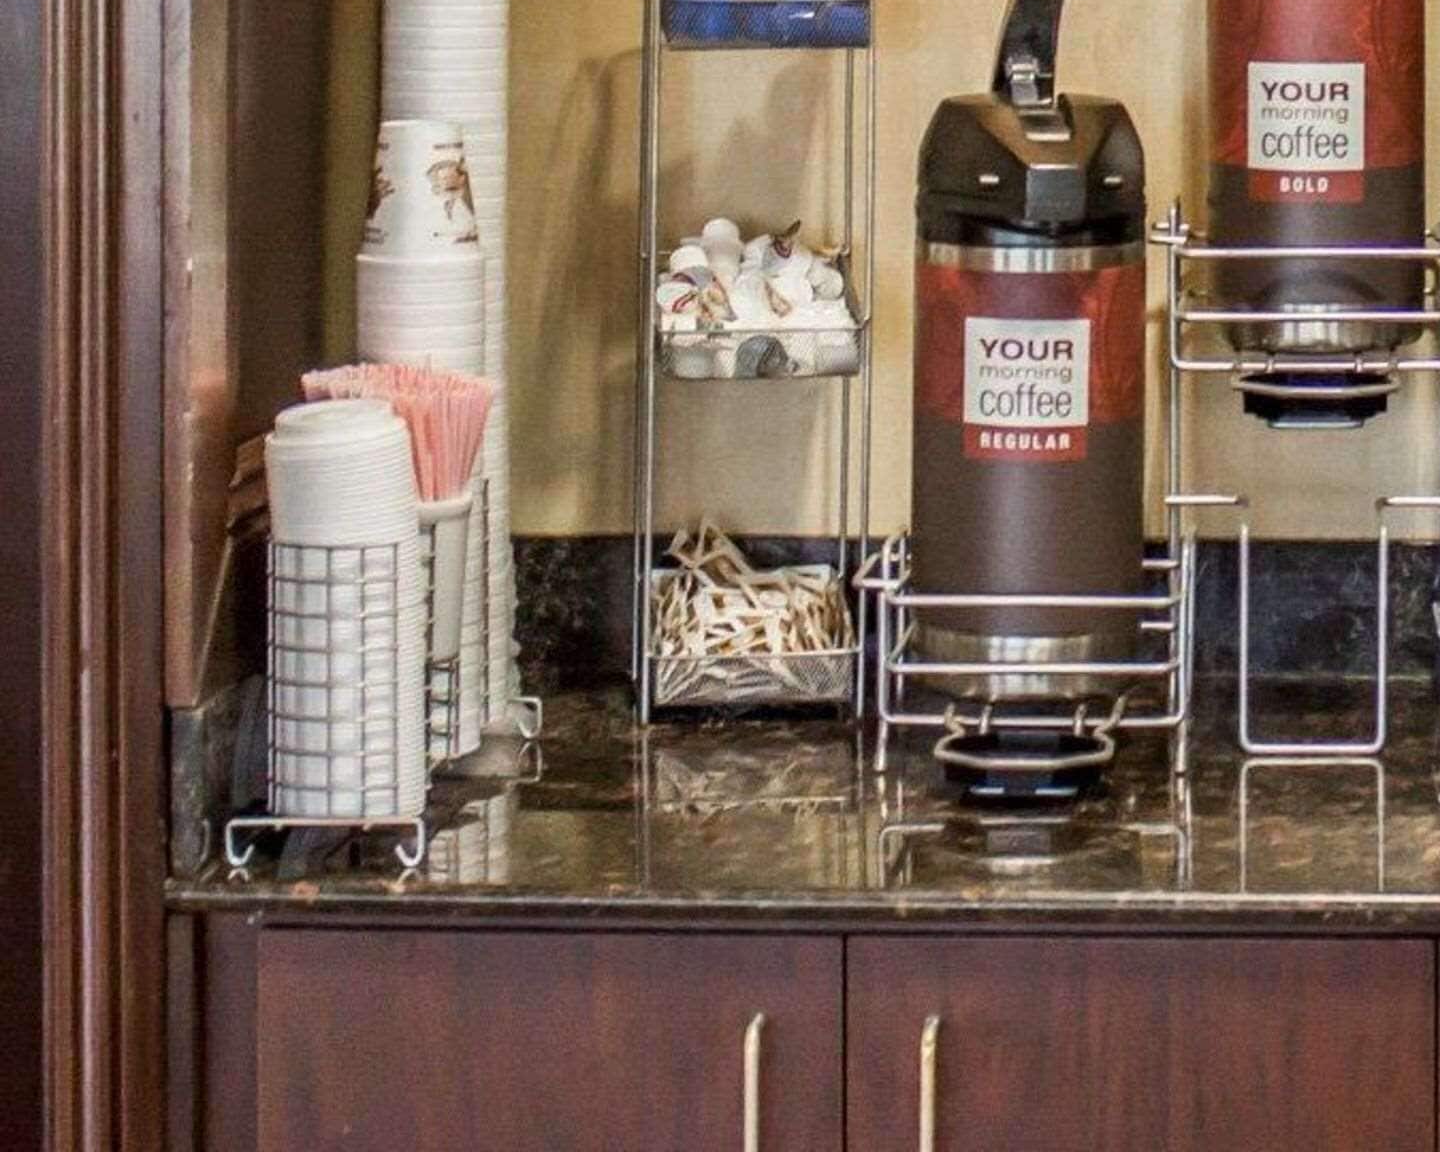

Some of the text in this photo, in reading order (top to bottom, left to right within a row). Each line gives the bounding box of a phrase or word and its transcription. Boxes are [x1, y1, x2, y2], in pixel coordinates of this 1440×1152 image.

[1260, 80, 1350, 102] YOUR
[1260, 105, 1349, 125] morning
[1260, 125, 1349, 159] coffee
[1279, 176, 1329, 193] BOLD
[979, 338, 1074, 361] YOUR
[979, 364, 1073, 384] morning
[979, 382, 1073, 418] coffee
[979, 430, 1071, 450] REGULAR
